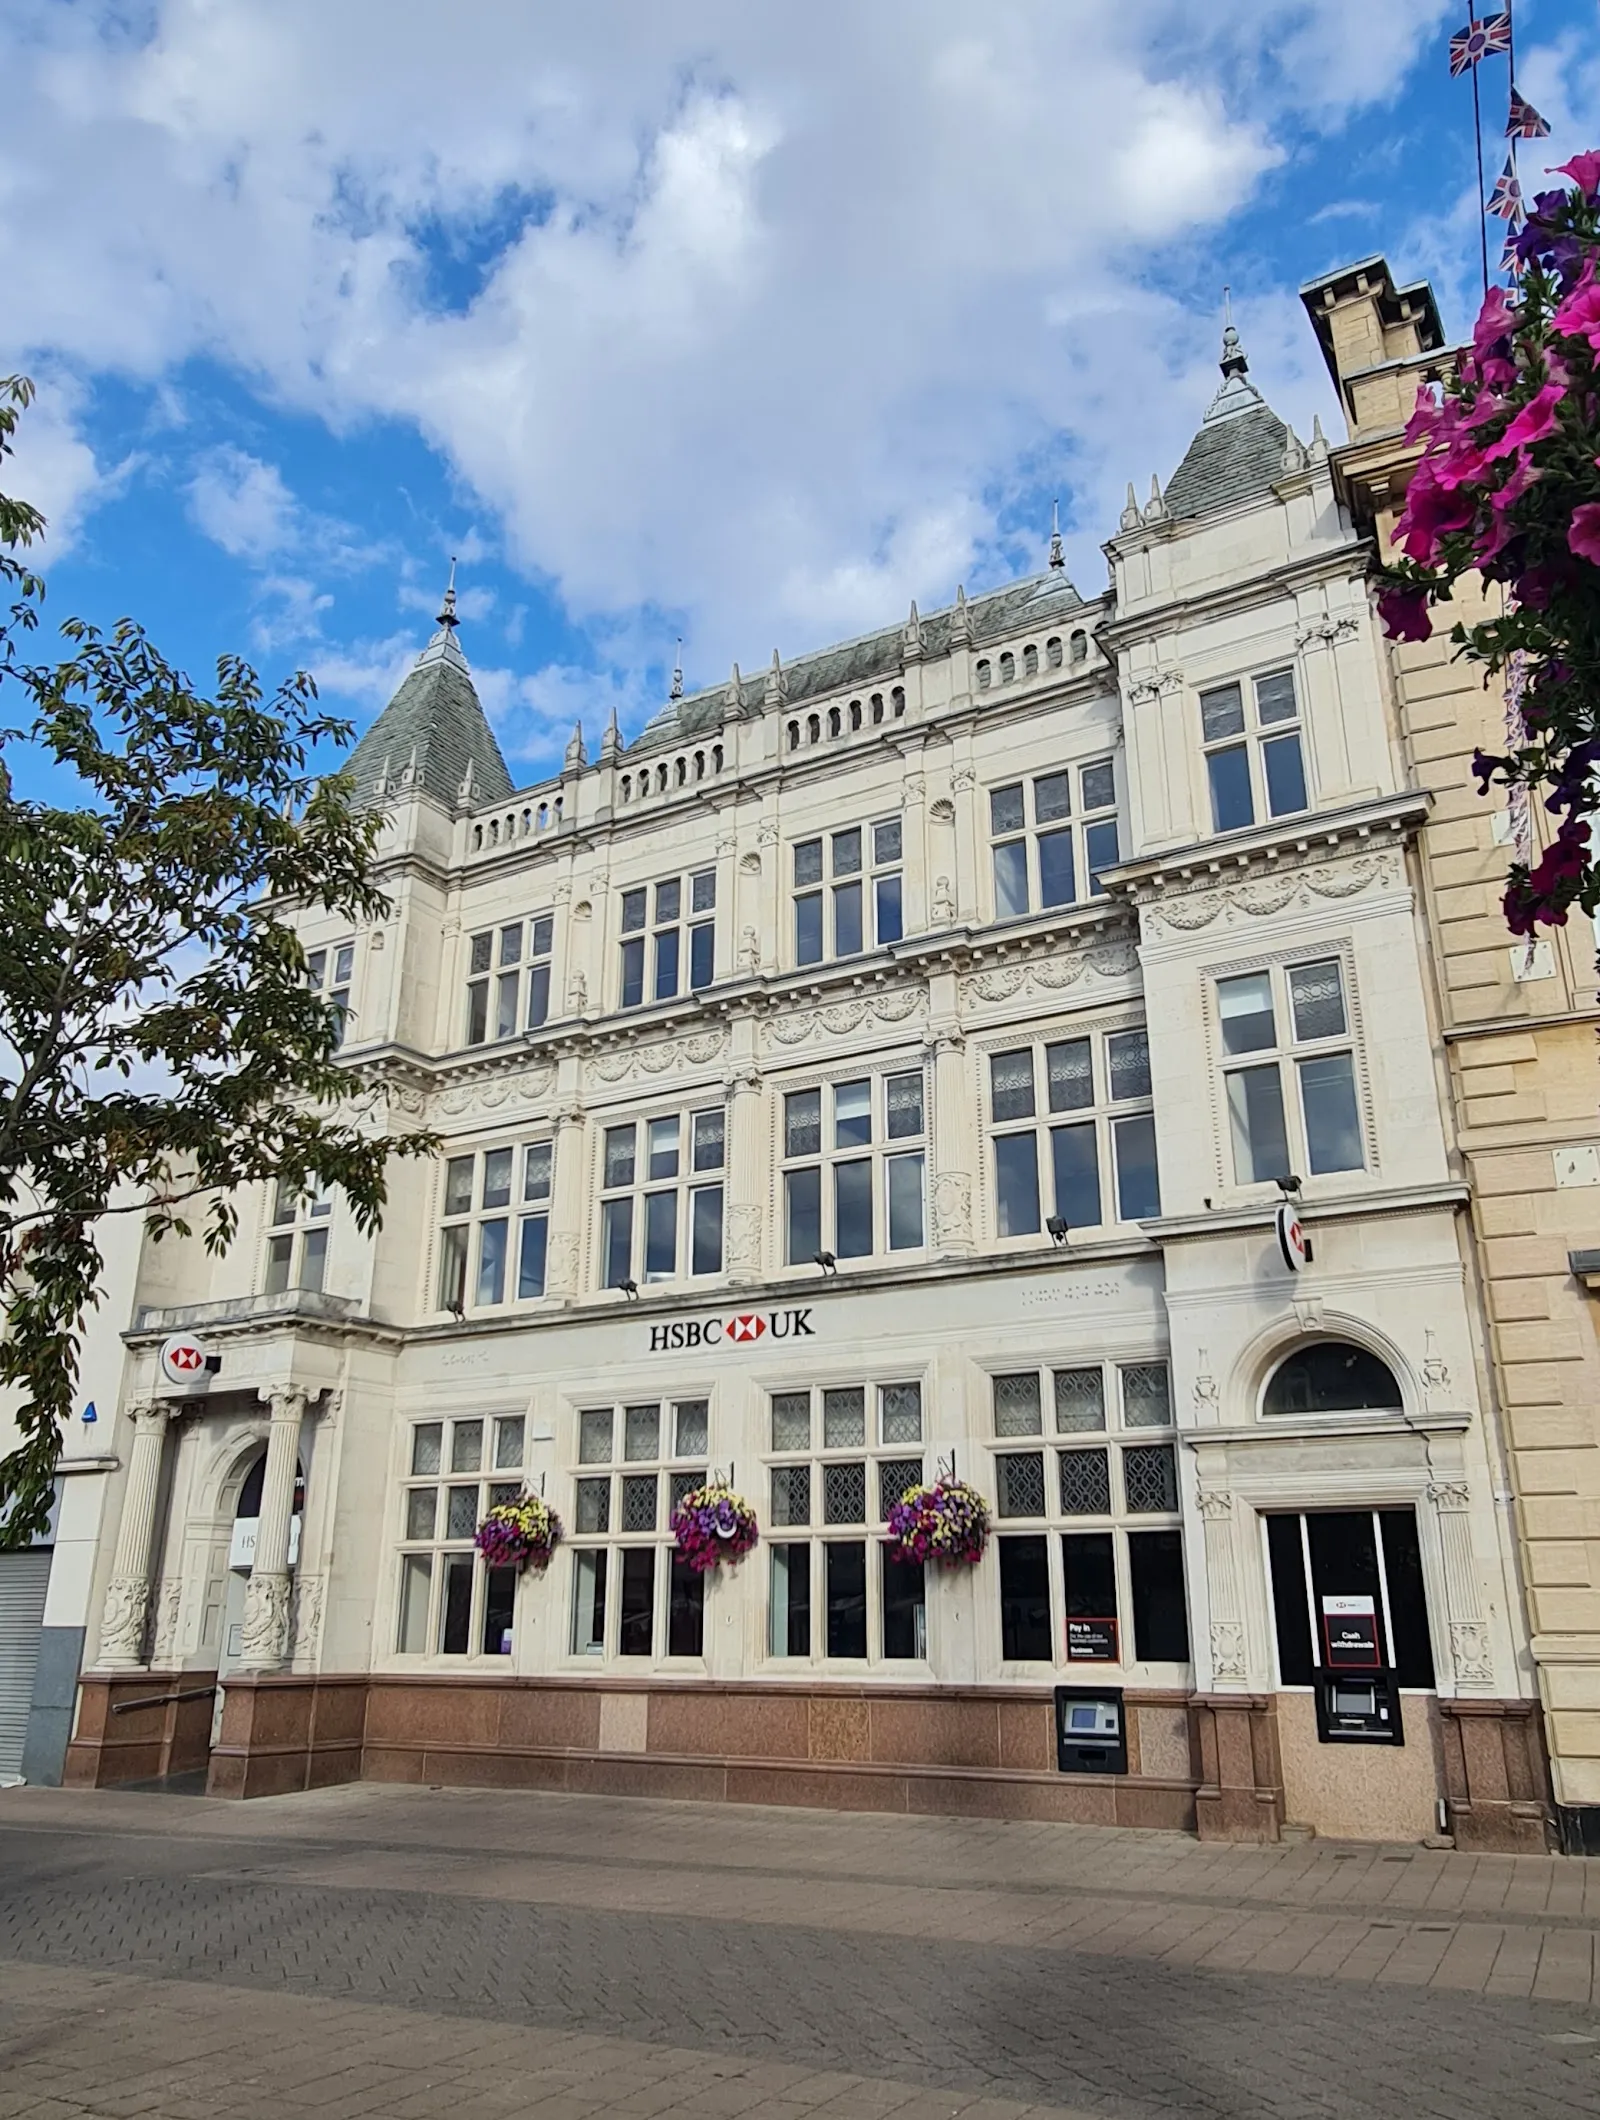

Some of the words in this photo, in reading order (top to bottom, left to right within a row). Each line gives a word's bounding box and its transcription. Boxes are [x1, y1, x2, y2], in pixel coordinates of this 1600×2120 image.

[649, 1319, 722, 1352] HSBC
[769, 1308, 816, 1339] UK
[1070, 1624, 1082, 1633] Pay
[1083, 1624, 1090, 1632] in
[1342, 1631, 1360, 1640] Cash
